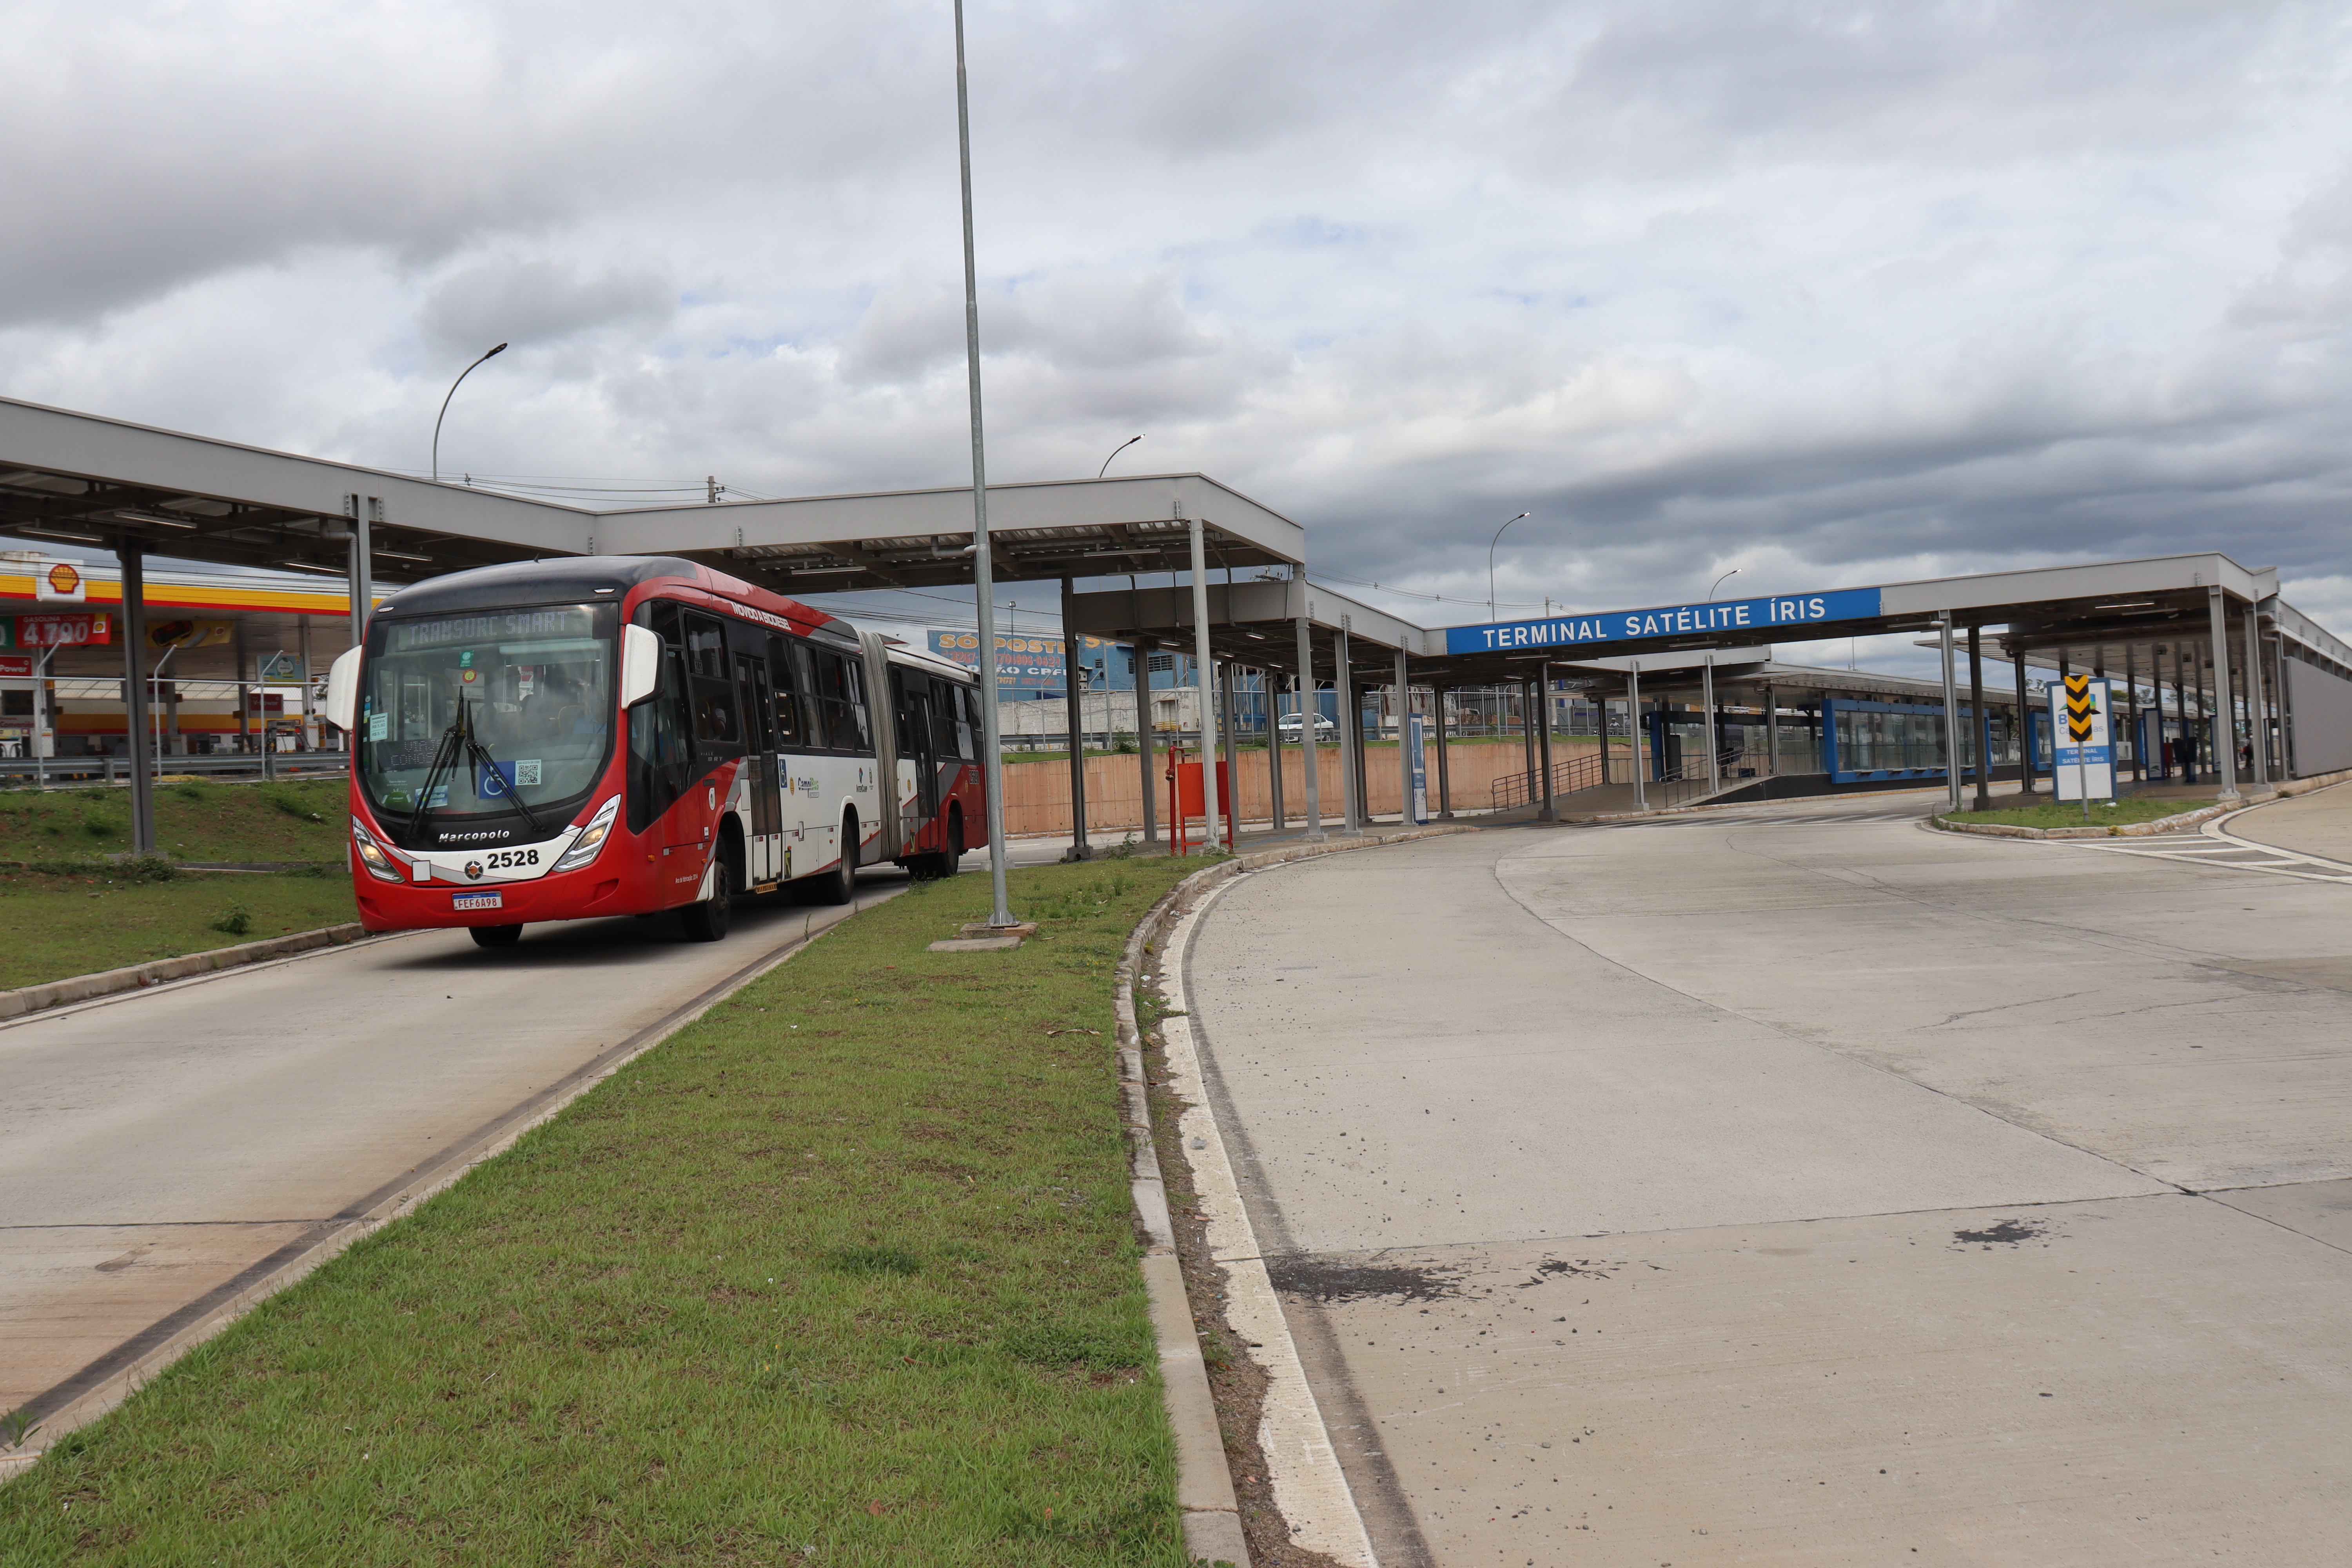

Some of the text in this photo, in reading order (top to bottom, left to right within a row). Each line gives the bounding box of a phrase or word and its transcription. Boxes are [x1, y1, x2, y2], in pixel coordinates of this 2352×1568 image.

[505, 611, 568, 634] SMART
[731, 602, 792, 631] MOVIDO A BIODIESEL
[1483, 598, 1826, 648] TERMINAL SATÉLITE ÍRIS
[938, 633, 978, 649] SÓ
[2059, 726, 2104, 735] Caas
[439, 829, 510, 842] Marcopolo
[487, 849, 539, 869] 2528
[458, 898, 497, 908] FEF6A98
